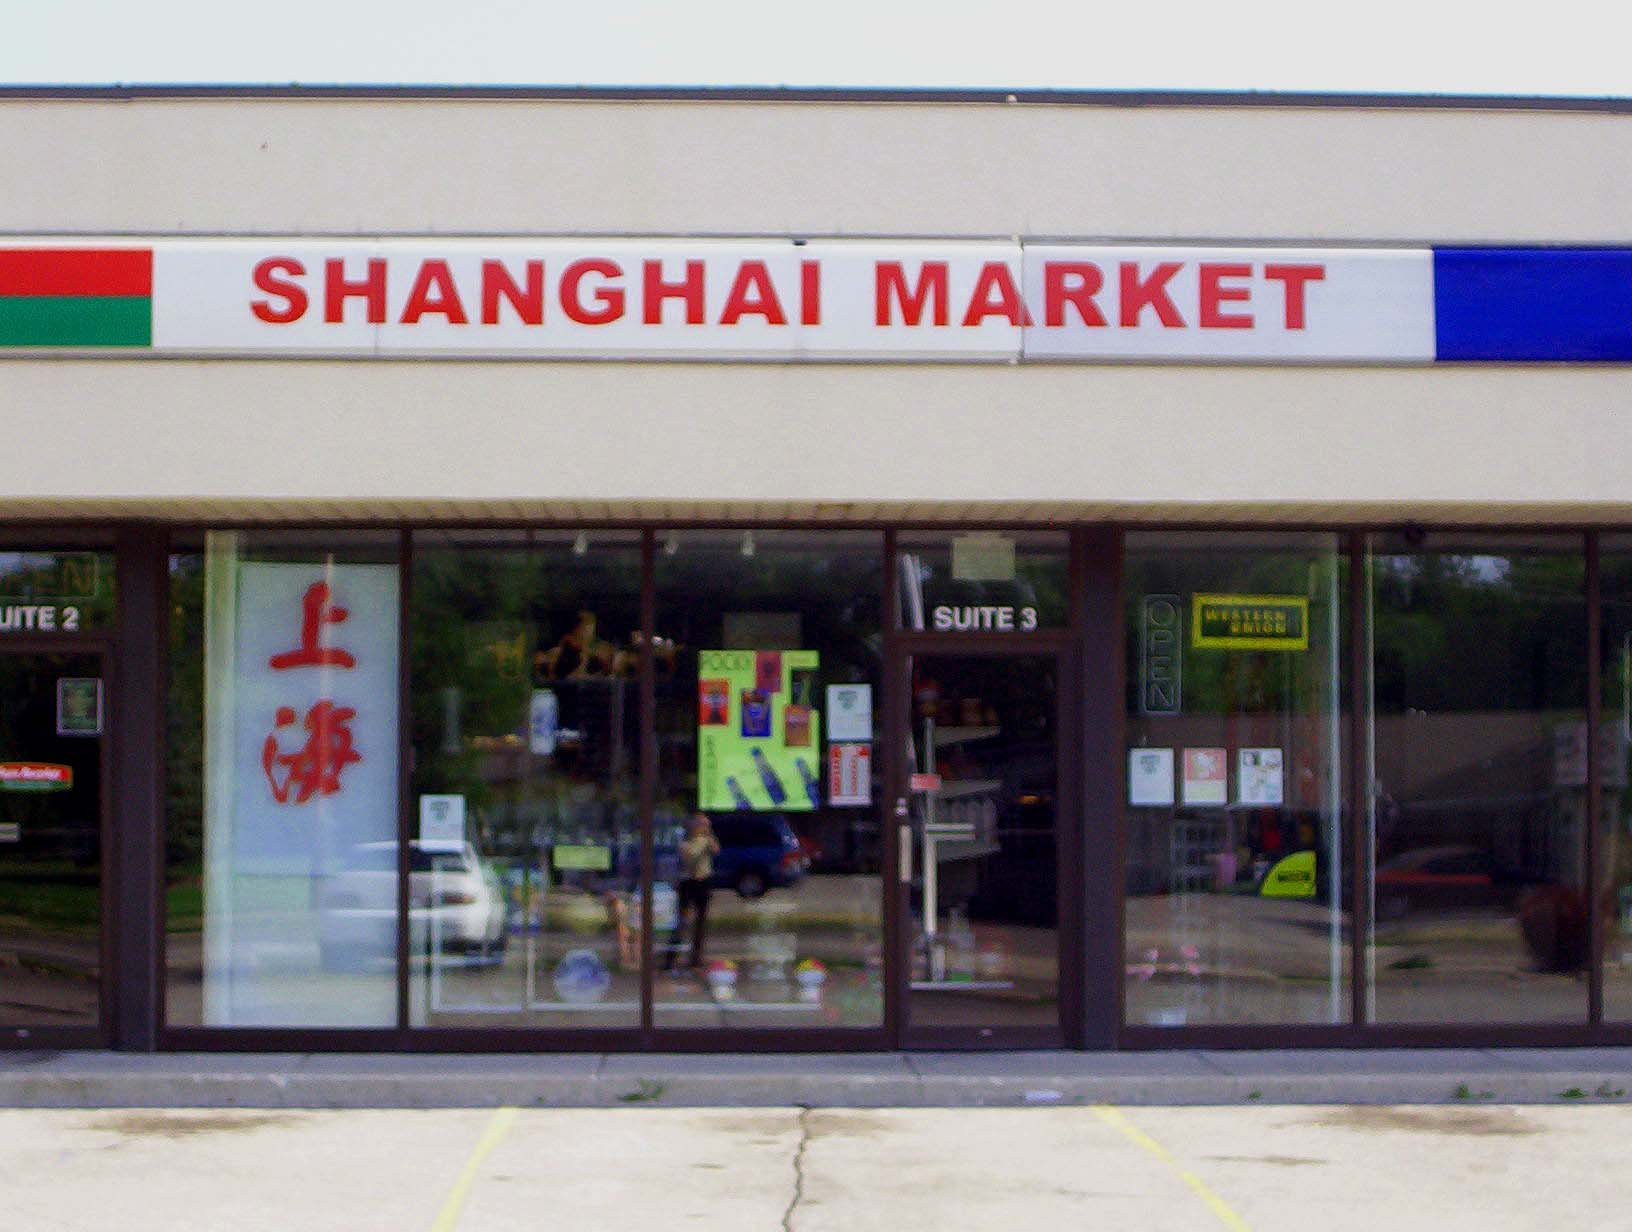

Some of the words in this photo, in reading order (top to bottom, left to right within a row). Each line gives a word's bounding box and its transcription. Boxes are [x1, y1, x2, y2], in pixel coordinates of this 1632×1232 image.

[251, 257, 820, 325] SHANGHAI
[874, 260, 1326, 330] MARKET
[63, 606, 80, 631] 2
[934, 606, 1014, 631] SUITE
[1022, 606, 1038, 631] 3
